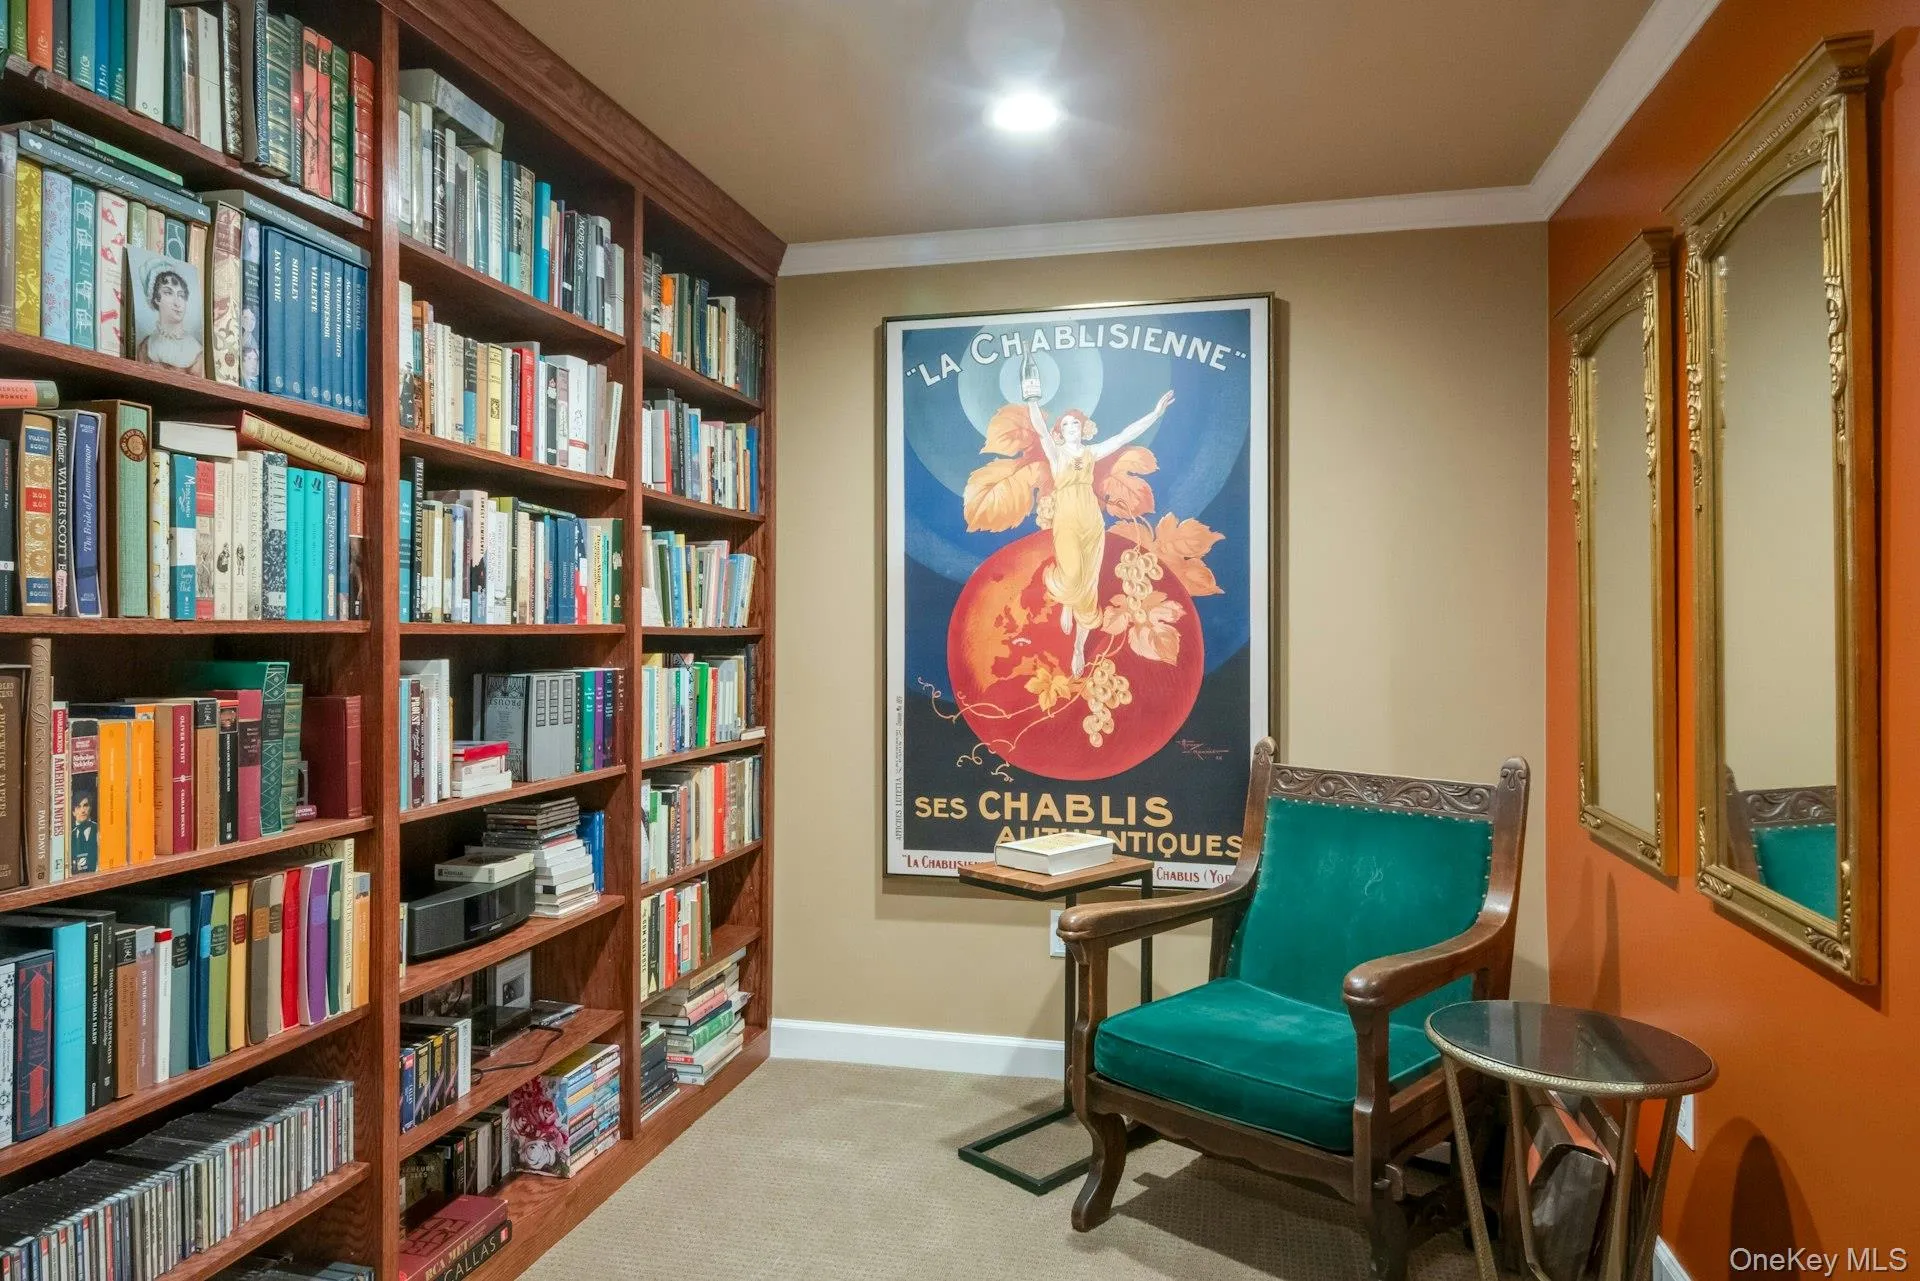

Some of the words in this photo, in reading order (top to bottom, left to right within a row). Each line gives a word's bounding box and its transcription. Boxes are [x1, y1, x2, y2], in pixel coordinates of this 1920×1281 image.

[513, 177, 521, 222] MELVILLE
[274, 249, 282, 275] JANE
[291, 258, 299, 301] SHIRLEY
[323, 271, 331, 287] THE
[274, 275, 282, 302] EYRE
[310, 266, 319, 314] VILLETTE
[335, 276, 343, 322] WUTHERING
[323, 287, 331, 339] PROFESSOR
[335, 322, 343, 358] HEIGHTS
[29, 443, 48, 451] SCOTT
[57, 426, 67, 463] Millgate
[270, 428, 294, 447] Pride
[294, 438, 308, 452] and
[309, 444, 344, 468] Prejudice
[83, 443, 92, 498] Lammermoor
[416, 462, 424, 498] WILLIAM
[57, 466, 67, 517] WALTER
[184, 475, 196, 518] MIDDLEMARCH
[326, 479, 336, 508] GREAT
[58, 519, 67, 560] SCOTT
[83, 510, 92, 536] Bride
[415, 500, 424, 543] FAULKNER
[83, 537, 92, 553] The
[326, 510, 337, 571] EXPECTATIONS
[31, 643, 51, 699] CHARLES
[411, 696, 421, 725] PROUST
[489, 698, 521, 707] PROUST
[31, 702, 51, 765] DICKENS
[35, 779, 46, 795] TO
[54, 757, 65, 806] AMERICAN
[38, 809, 46, 831] PAUL
[53, 807, 64, 837] NOTES
[915, 796, 968, 820] SES
[978, 790, 1174, 828] CHABLIS
[38, 833, 46, 860] DAVIS
[998, 825, 1243, 859] ANTIQUES
[922, 855, 984, 869] CHABLISI
[1156, 866, 1200, 884] CHABLIS
[344, 878, 352, 923] COUNTRY
[443, 1235, 496, 1281] CALLAS
